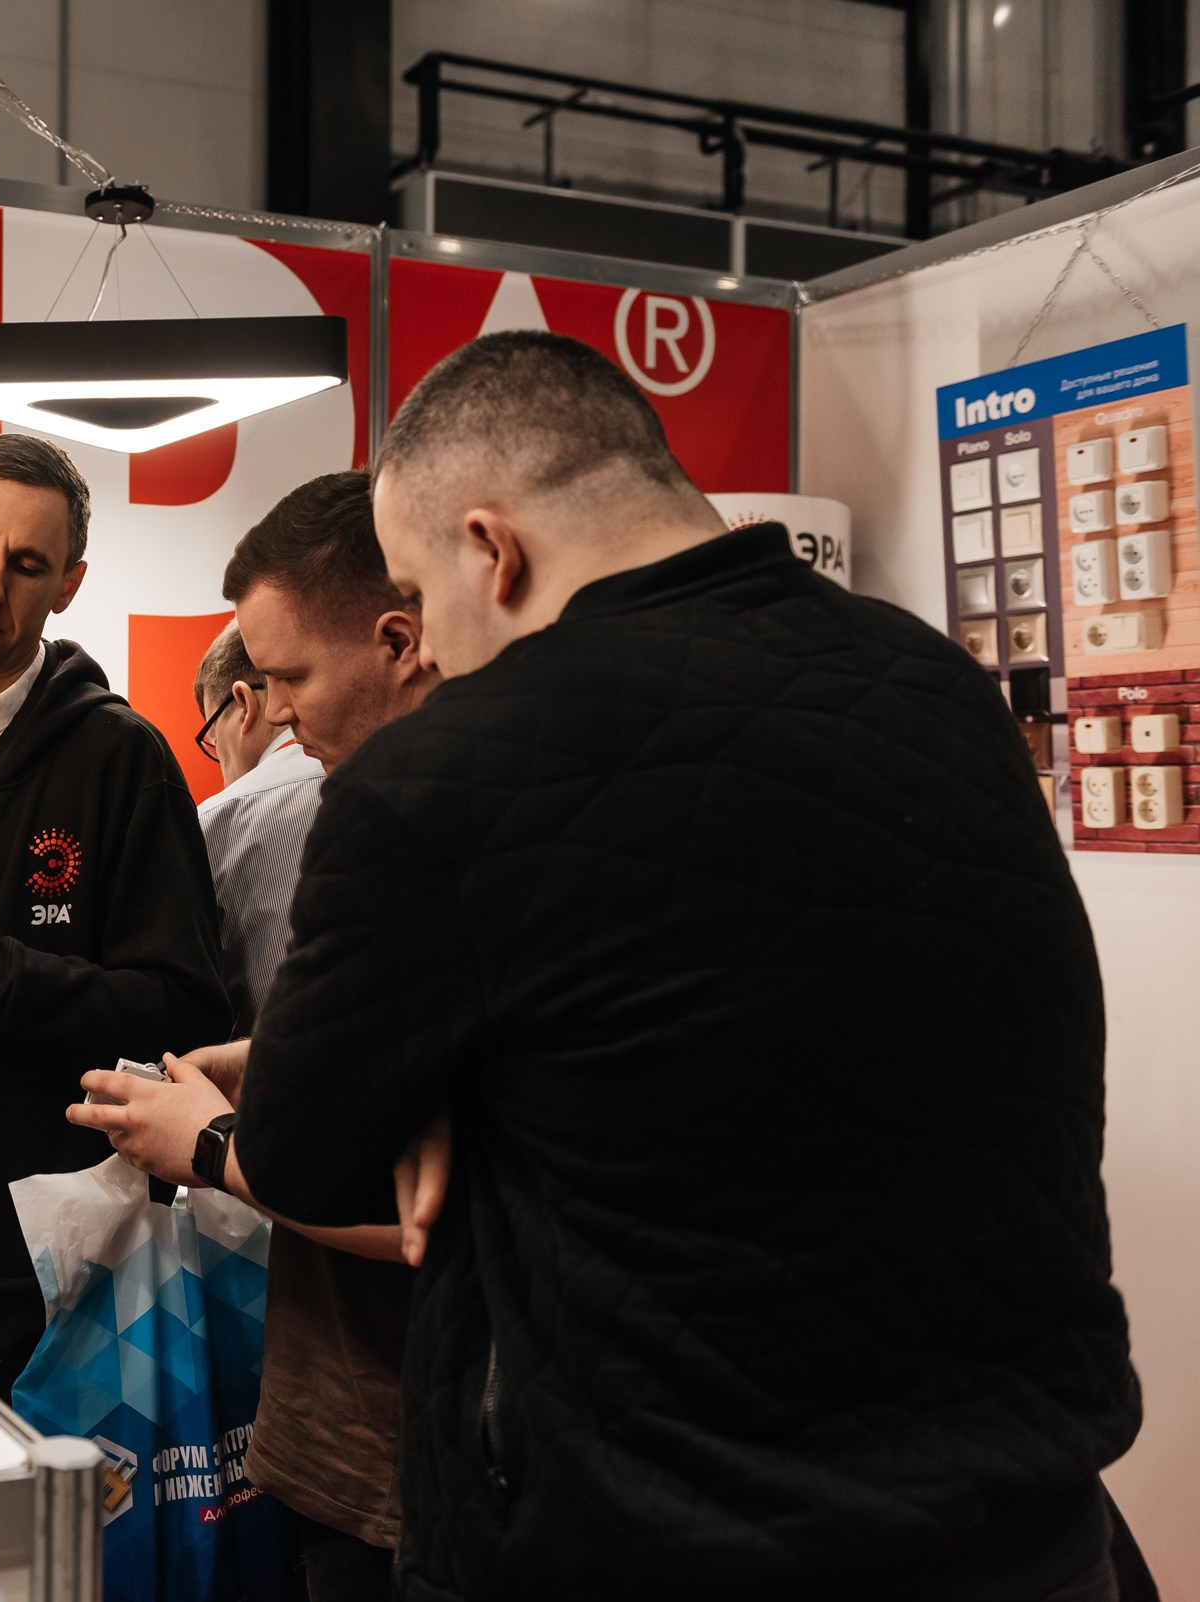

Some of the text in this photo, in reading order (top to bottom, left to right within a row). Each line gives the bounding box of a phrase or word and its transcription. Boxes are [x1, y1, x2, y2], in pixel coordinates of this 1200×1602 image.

[1076, 373, 1160, 401] для вашего дома
[954, 387, 1037, 430] Intro
[1094, 406, 1144, 425] Quadro
[957, 438, 990, 457] Piano
[1003, 429, 1032, 447] Solo
[795, 533, 846, 574] ЭРА
[1117, 686, 1148, 701] Polo
[152, 1446, 208, 1475] ФОРУМ
